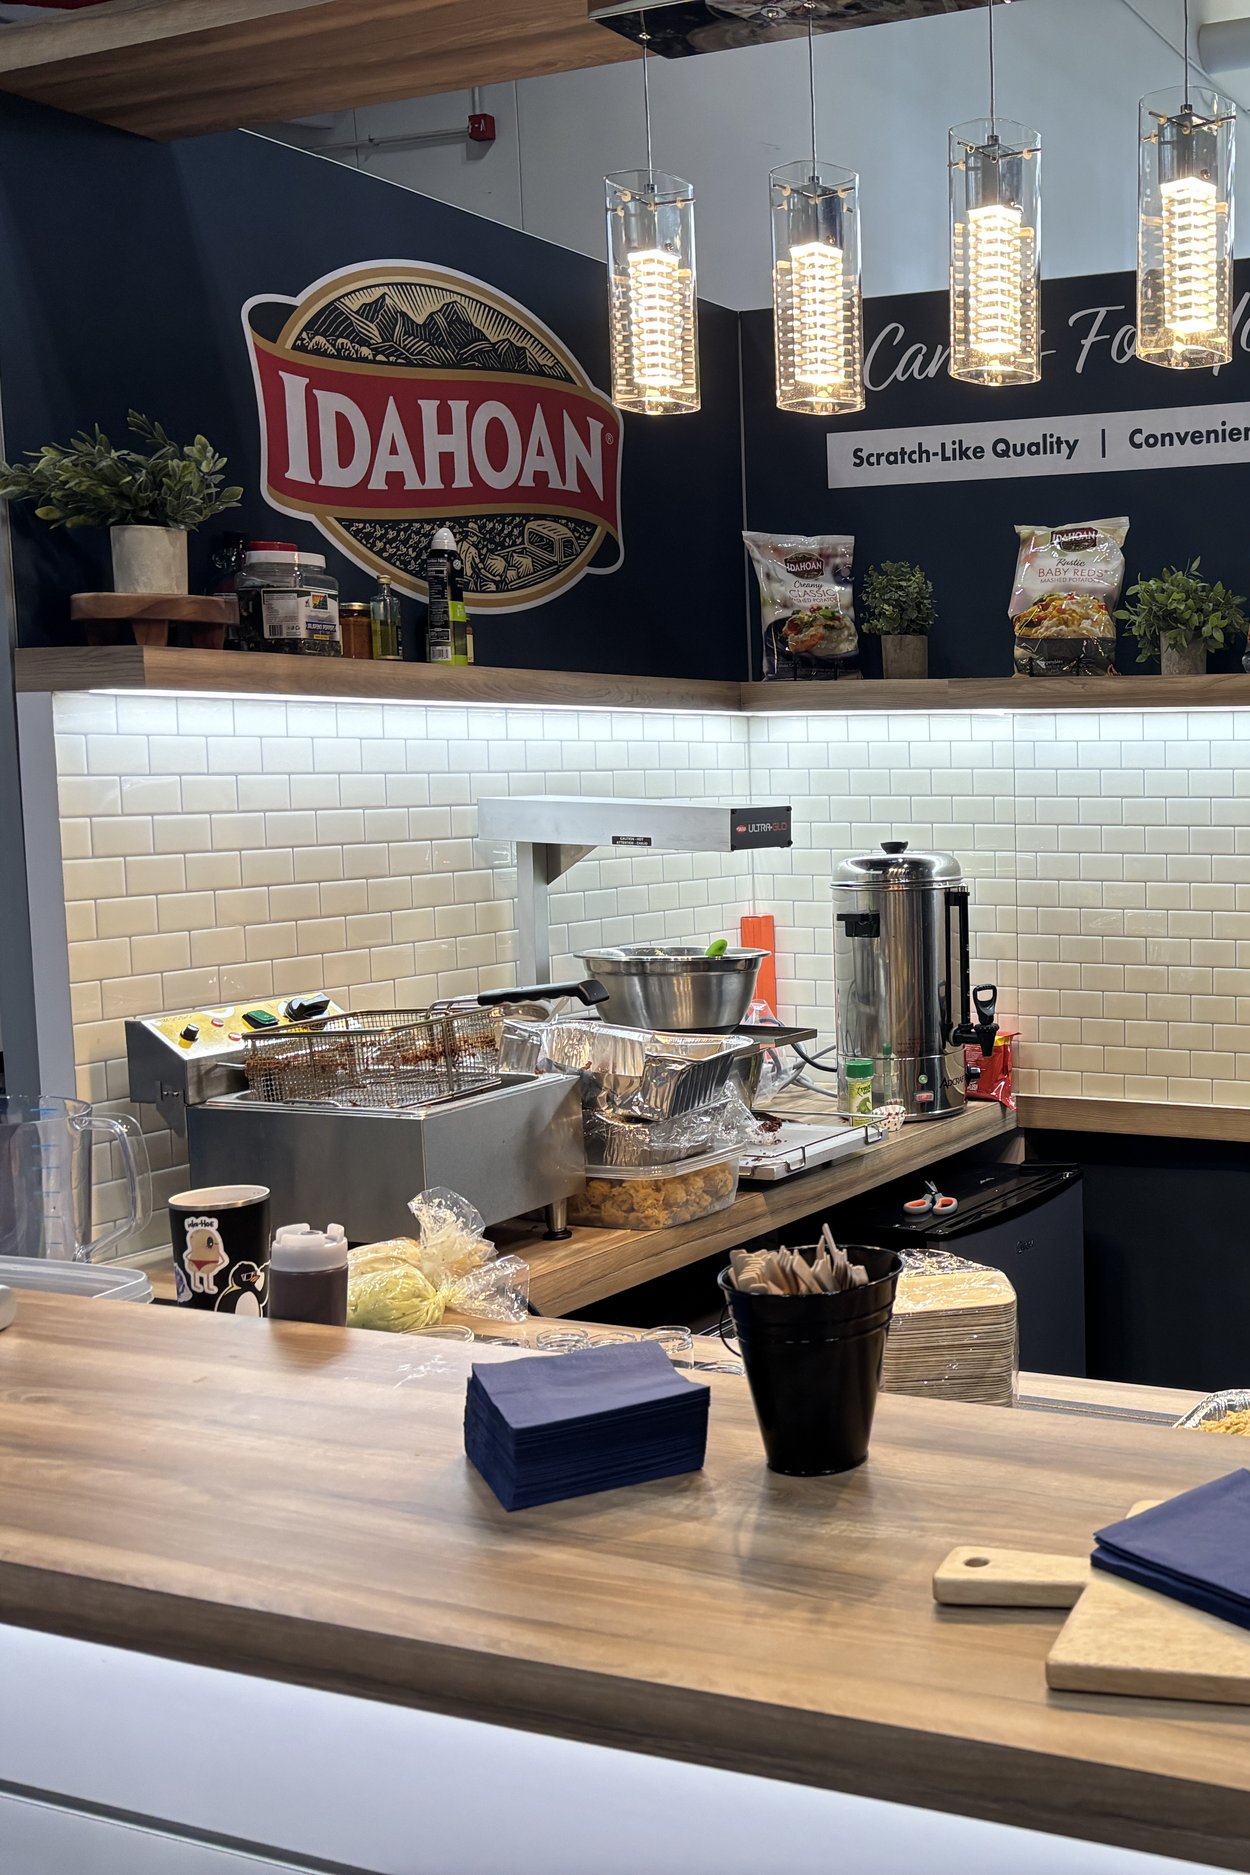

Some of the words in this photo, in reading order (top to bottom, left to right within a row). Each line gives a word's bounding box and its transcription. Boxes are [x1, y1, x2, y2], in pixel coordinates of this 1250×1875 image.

[1068, 305, 1137, 374] Fo
[853, 440, 984, 467] Scratch-Like
[992, 433, 1079, 459] Quality
[1056, 558, 1086, 567] Rustic
[1038, 568, 1069, 577] BABY
[793, 580, 823, 591] Creamy
[789, 588, 837, 598] CLASSIC
